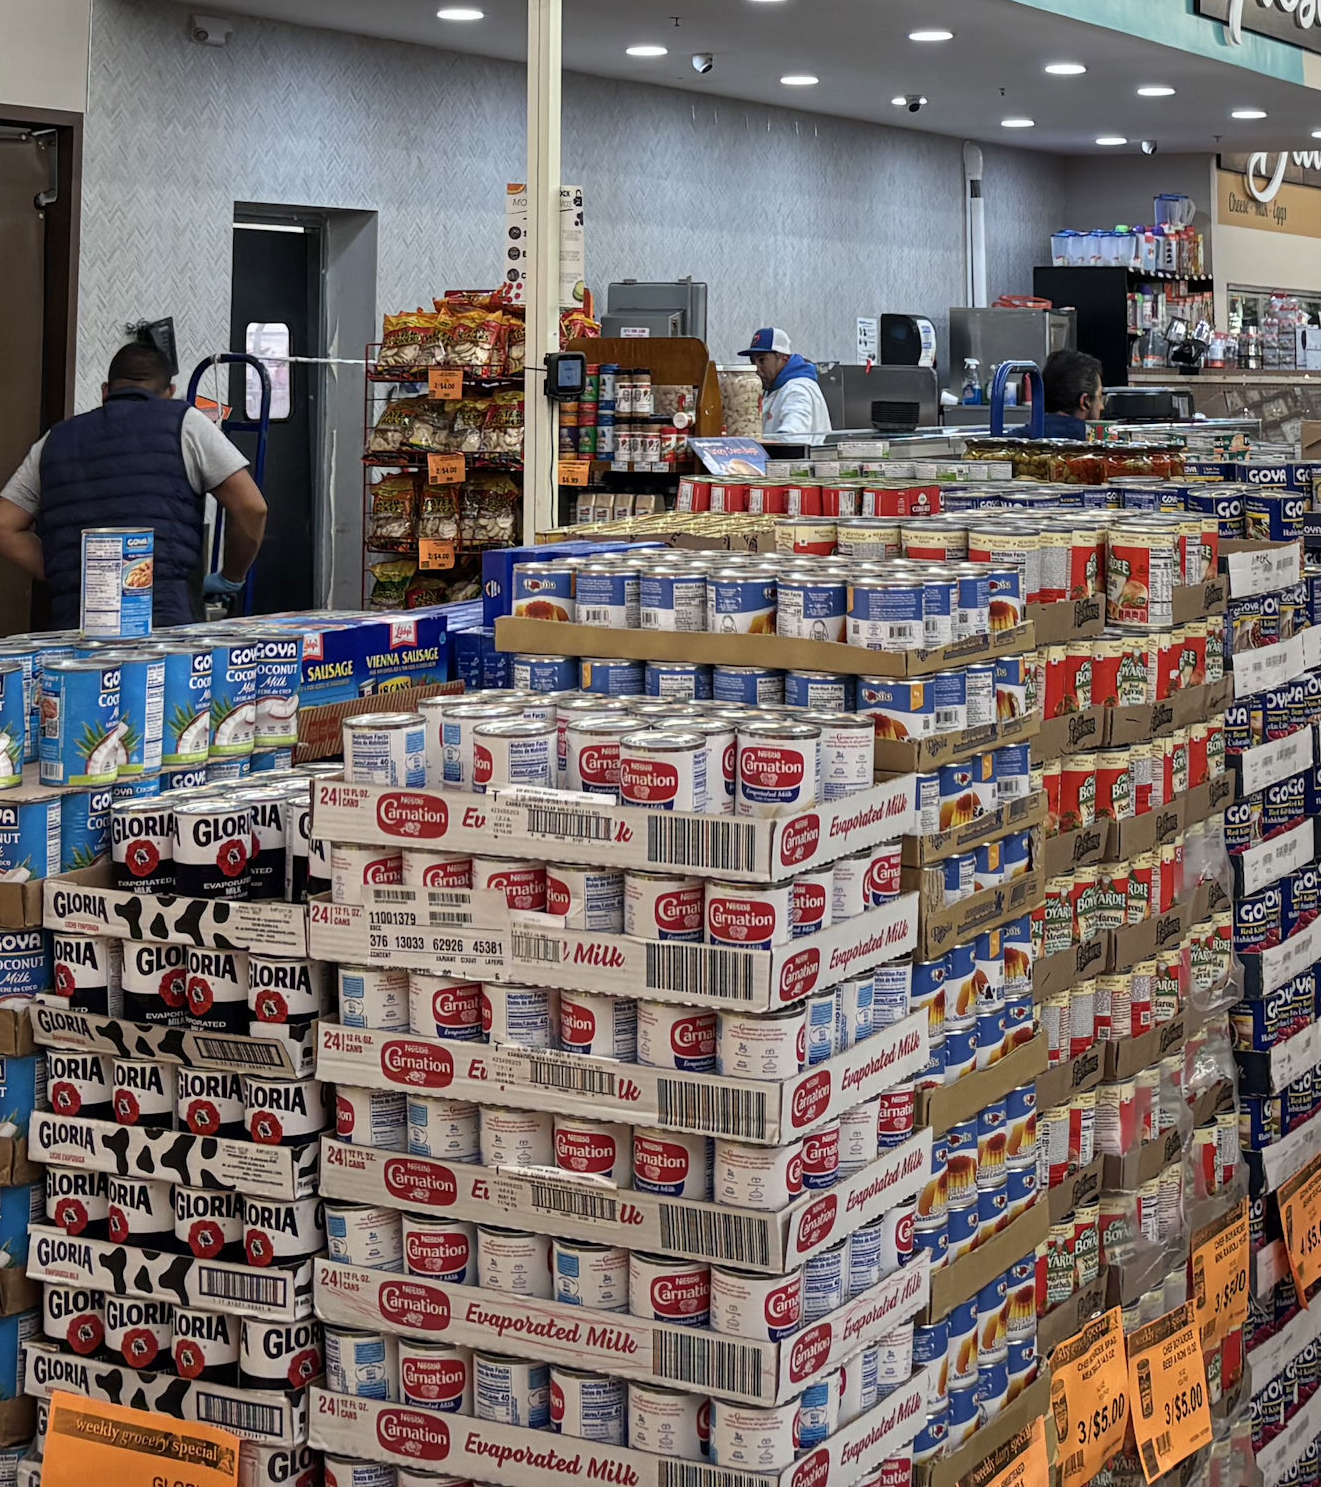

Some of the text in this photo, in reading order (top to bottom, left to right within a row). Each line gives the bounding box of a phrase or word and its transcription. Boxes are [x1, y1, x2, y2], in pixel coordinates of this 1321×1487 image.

[1249, 468, 1286, 483] GOYA
[307, 661, 354, 682] SAUSAGE
[366, 647, 439, 669] VIENNA SAUSAGE
[620, 761, 676, 787] Carnation
[741, 749, 802, 775] Carnation
[321, 786, 337, 807] 24
[342, 788, 349, 798] 12
[351, 789, 358, 798] FL
[342, 797, 359, 808] CANS
[380, 799, 446, 824] Carnation
[829, 793, 907, 841] Evaporated Milk
[53, 890, 109, 920] GLORIA
[369, 911, 416, 926] 11001379
[709, 904, 774, 929] Carnation
[370, 934, 503, 955] 376 13033 62926 45381
[573, 941, 625, 969] Milk
[829, 919, 909, 972] Evaporated Milk
[0, 971, 31, 985] Milk
[37, 1009, 93, 1042] GLORIA
[385, 1049, 451, 1076] Carnation
[841, 1032, 920, 1090] Evaporated Milk
[180, 1069, 244, 1099] GLORIA
[39, 1119, 95, 1154] GLORIA
[556, 1139, 614, 1159] Carnation
[327, 1145, 344, 1164] 24
[388, 1168, 456, 1193] Carnation
[36, 1237, 94, 1276] GLORIA
[48, 1289, 104, 1319] GLOR
[380, 1288, 449, 1317] Carnation
[464, 1302, 639, 1355] Evaporated Milk
[34, 1352, 89, 1393] GLORIA
[318, 1394, 339, 1416] 24
[1165, 1382, 1204, 1426] 3/$5.00
[379, 1418, 448, 1447] Carnation
[1078, 1393, 1126, 1447] 3/$5.00
[76, 1416, 219, 1464] weekly grocery special
[463, 1431, 640, 1486] Evaporated Milk
